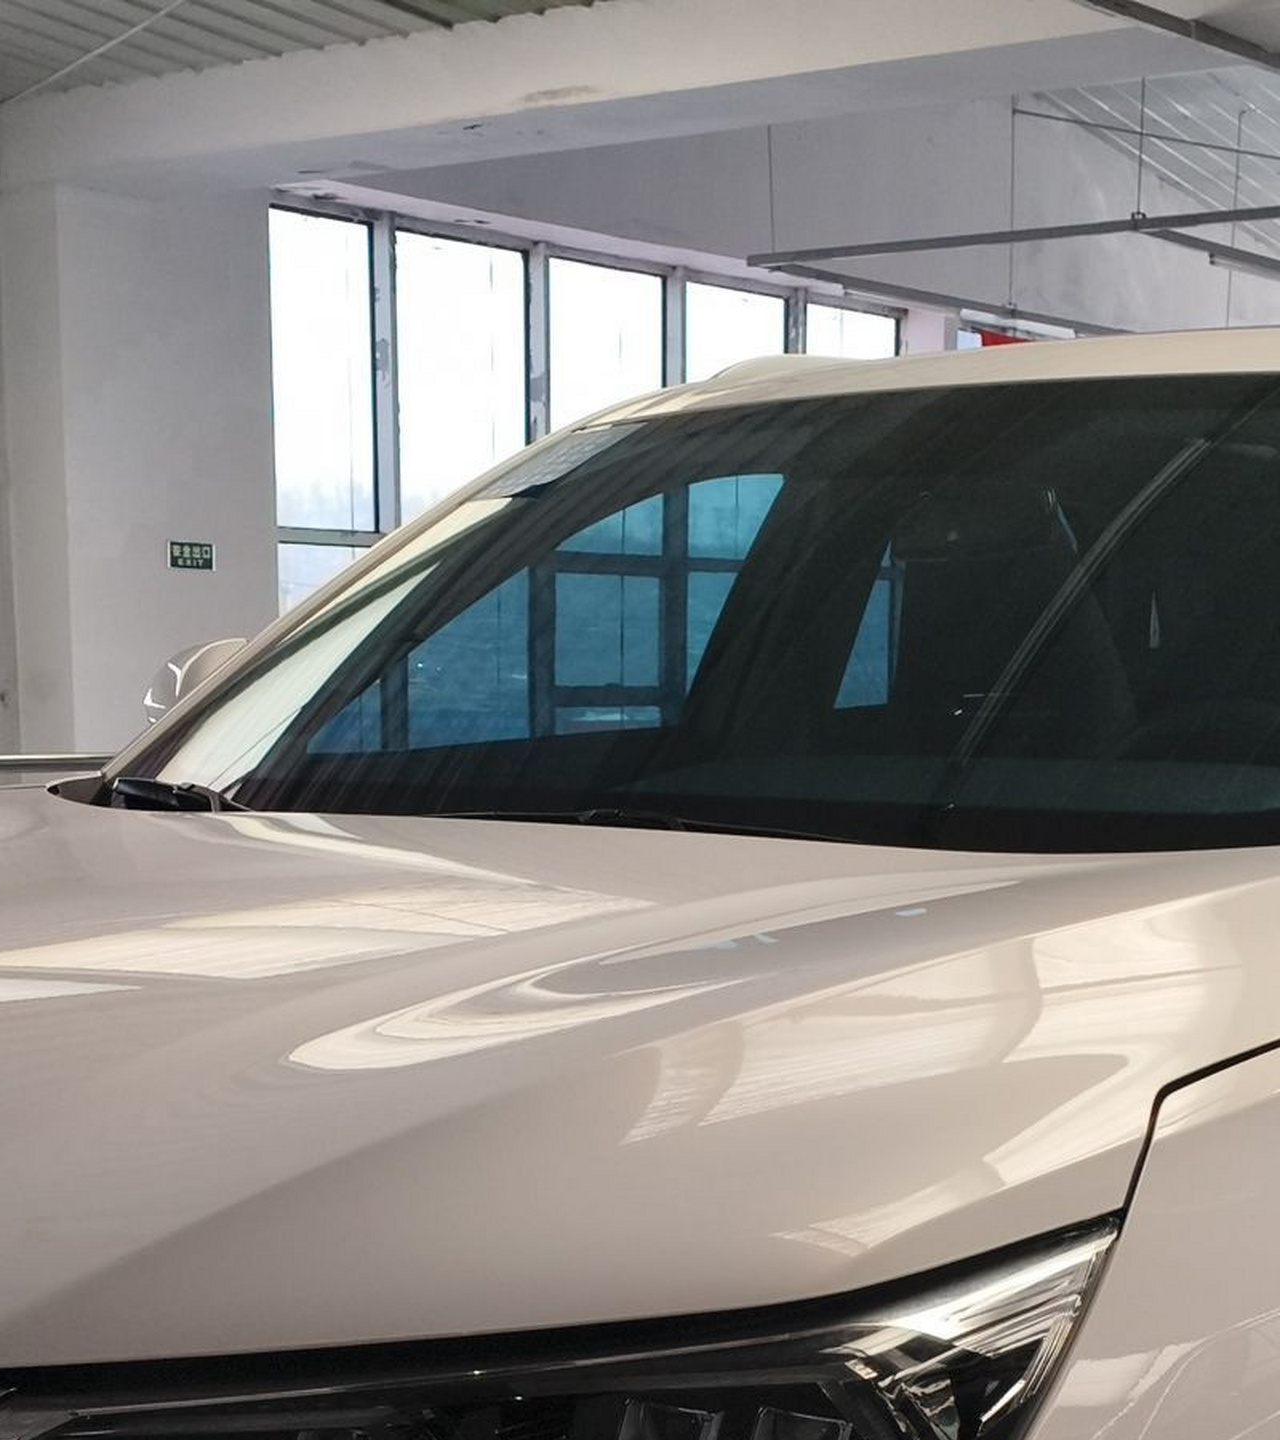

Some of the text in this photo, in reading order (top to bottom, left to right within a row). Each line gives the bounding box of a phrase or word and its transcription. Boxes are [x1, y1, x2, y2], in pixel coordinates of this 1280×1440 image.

[173, 545, 211, 558] 安全出口
[178, 559, 204, 567] EXIT
